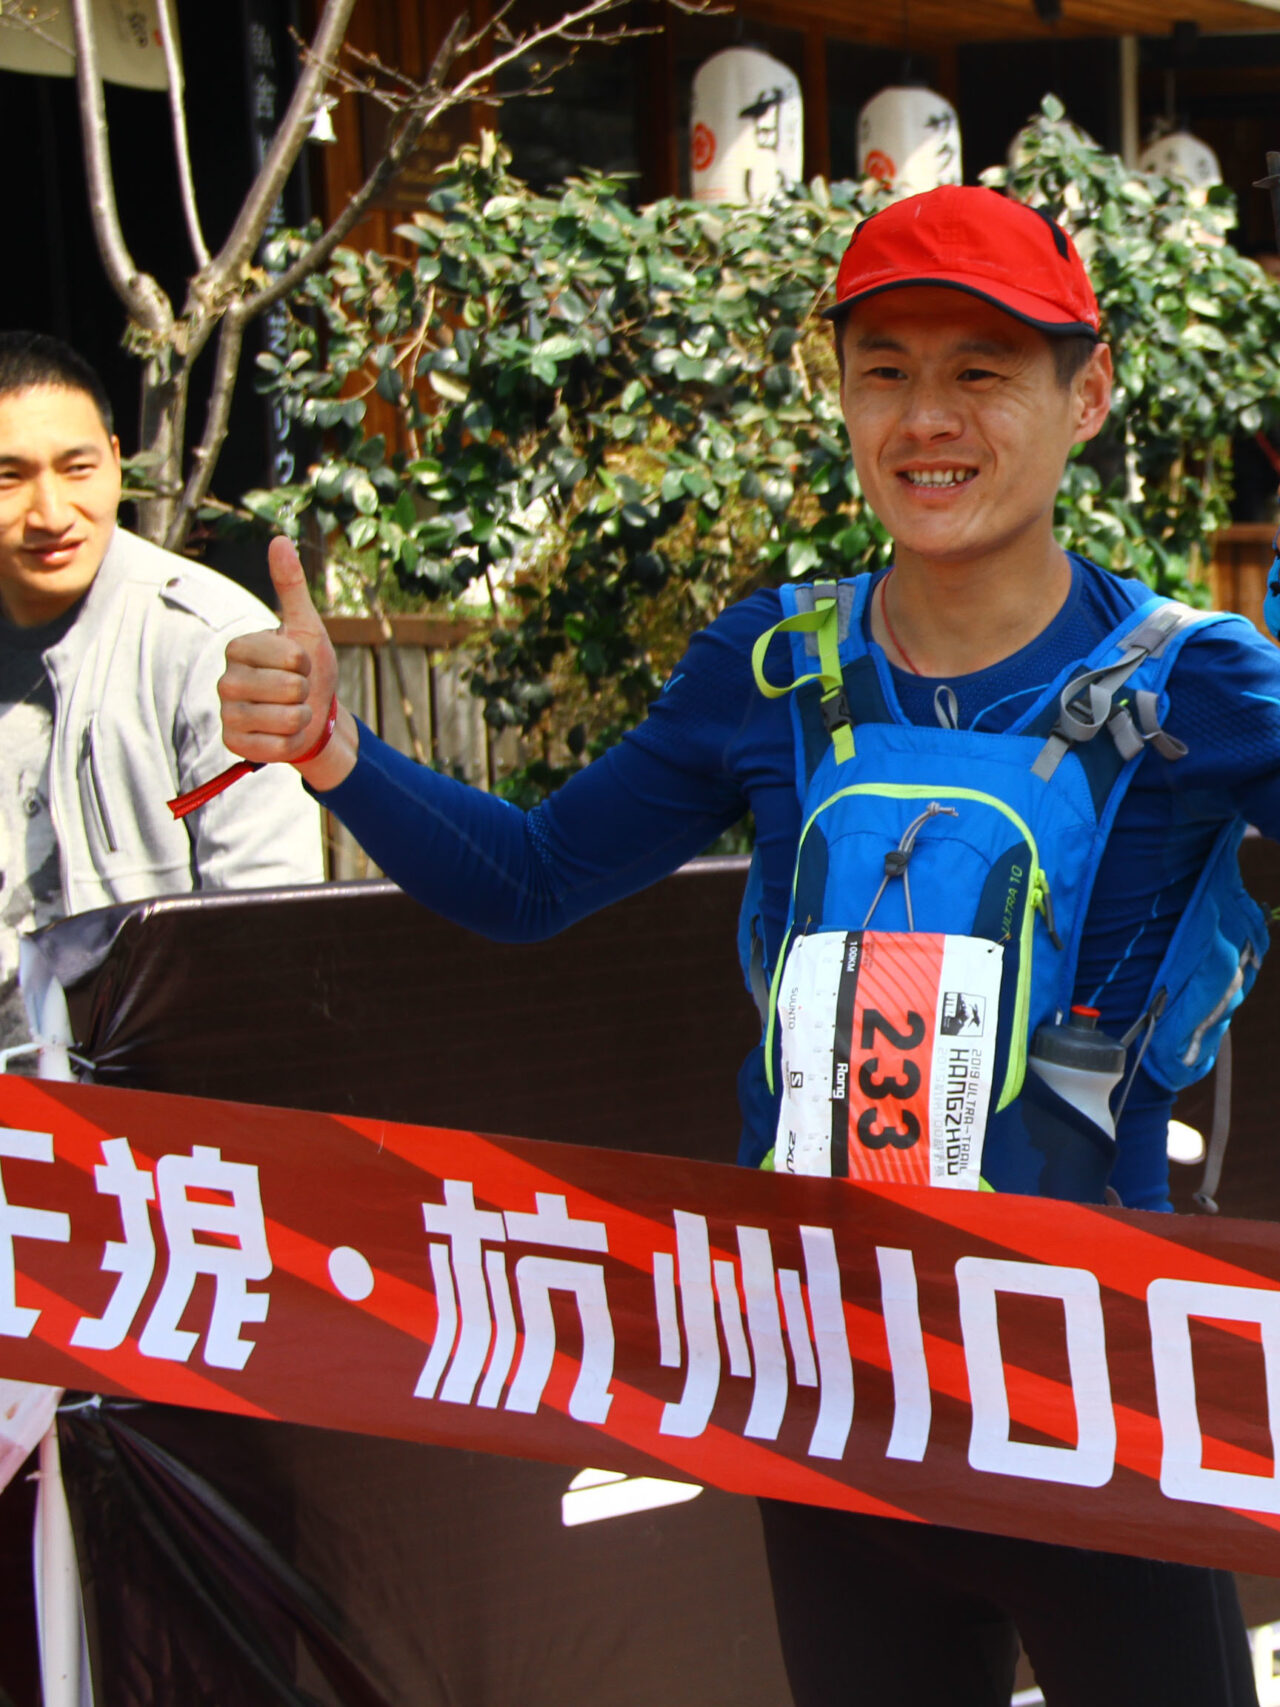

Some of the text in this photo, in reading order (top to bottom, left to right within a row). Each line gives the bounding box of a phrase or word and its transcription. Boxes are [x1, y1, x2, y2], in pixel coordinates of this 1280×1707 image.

[1002, 864, 1023, 934] ULTRA 10
[846, 940, 858, 973] 100KM
[788, 987, 799, 1030] SUUNTO
[832, 1062, 848, 1100] Rong
[857, 1008, 927, 1151] 233
[944, 1049, 970, 1176] HANGZHOU
[959, 1049, 982, 1172] 2019 ULTRA-TRAIL
